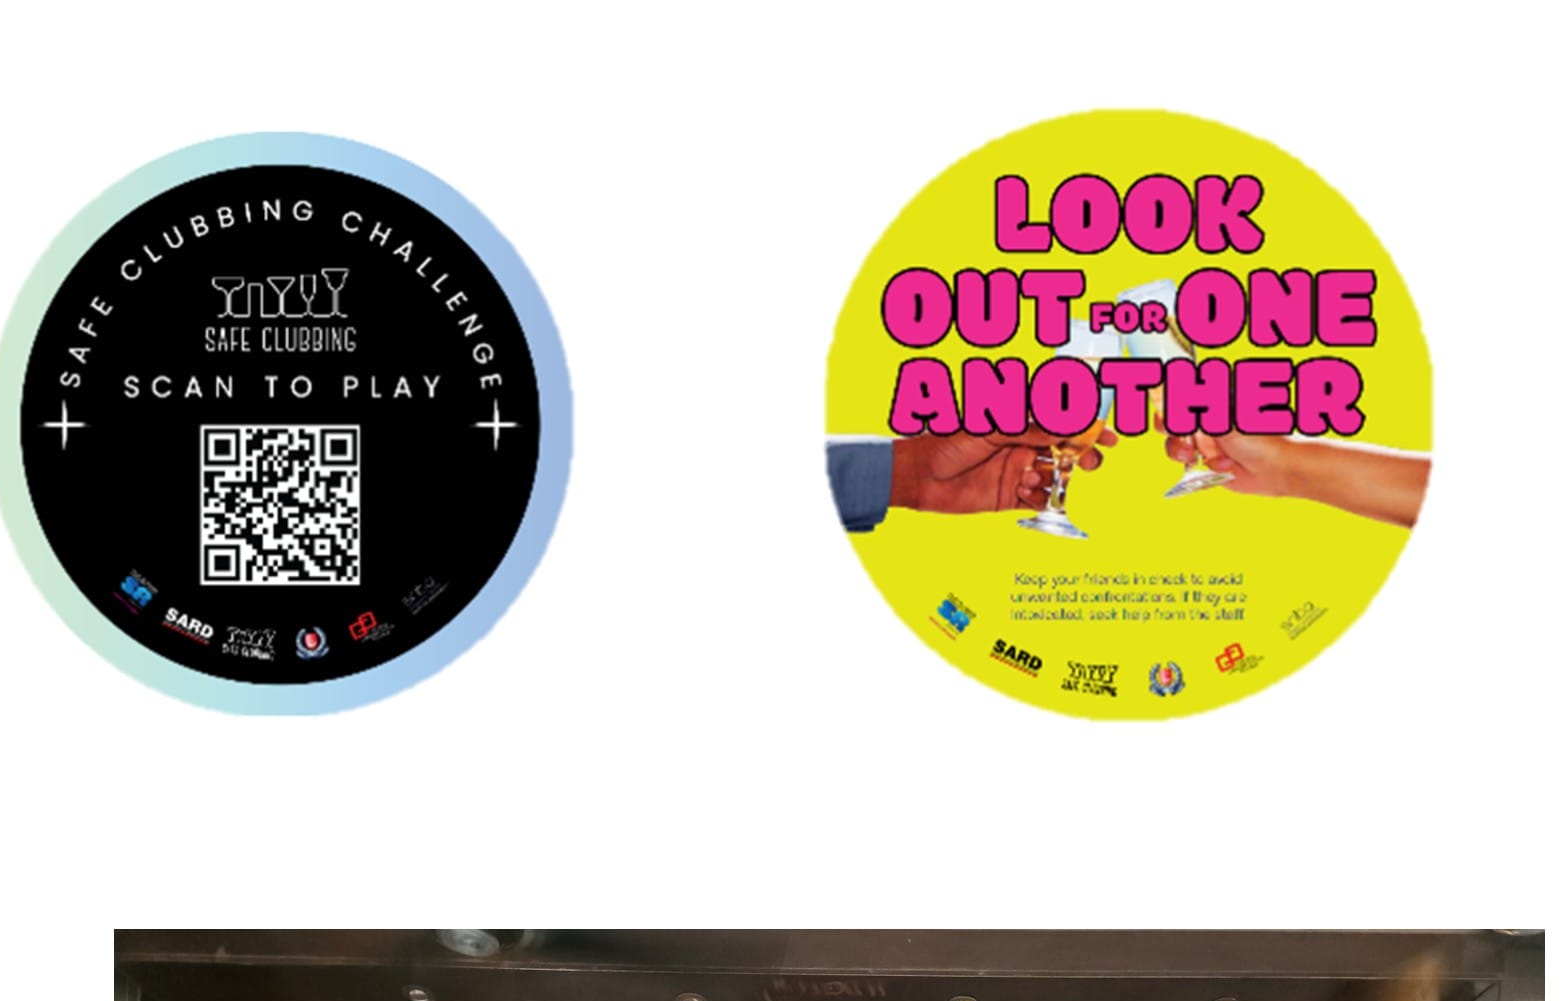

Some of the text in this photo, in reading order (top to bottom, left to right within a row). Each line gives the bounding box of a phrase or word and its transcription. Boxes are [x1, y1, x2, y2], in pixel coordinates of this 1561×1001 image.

[994, 172, 1266, 254] LOOK
[59, 199, 503, 389] SAFE CLUBBING CHALLENGE
[881, 267, 1377, 348] OUT FOR ONE
[205, 327, 357, 352] SAFE CLUBBING
[122, 375, 442, 399] SCAN TO PLAY
[887, 357, 1367, 436] ANOTHER
[1014, 573, 1047, 588] Keep
[1051, 577, 1079, 588] your
[164, 607, 214, 640] SARD
[993, 638, 1042, 672] SARD
